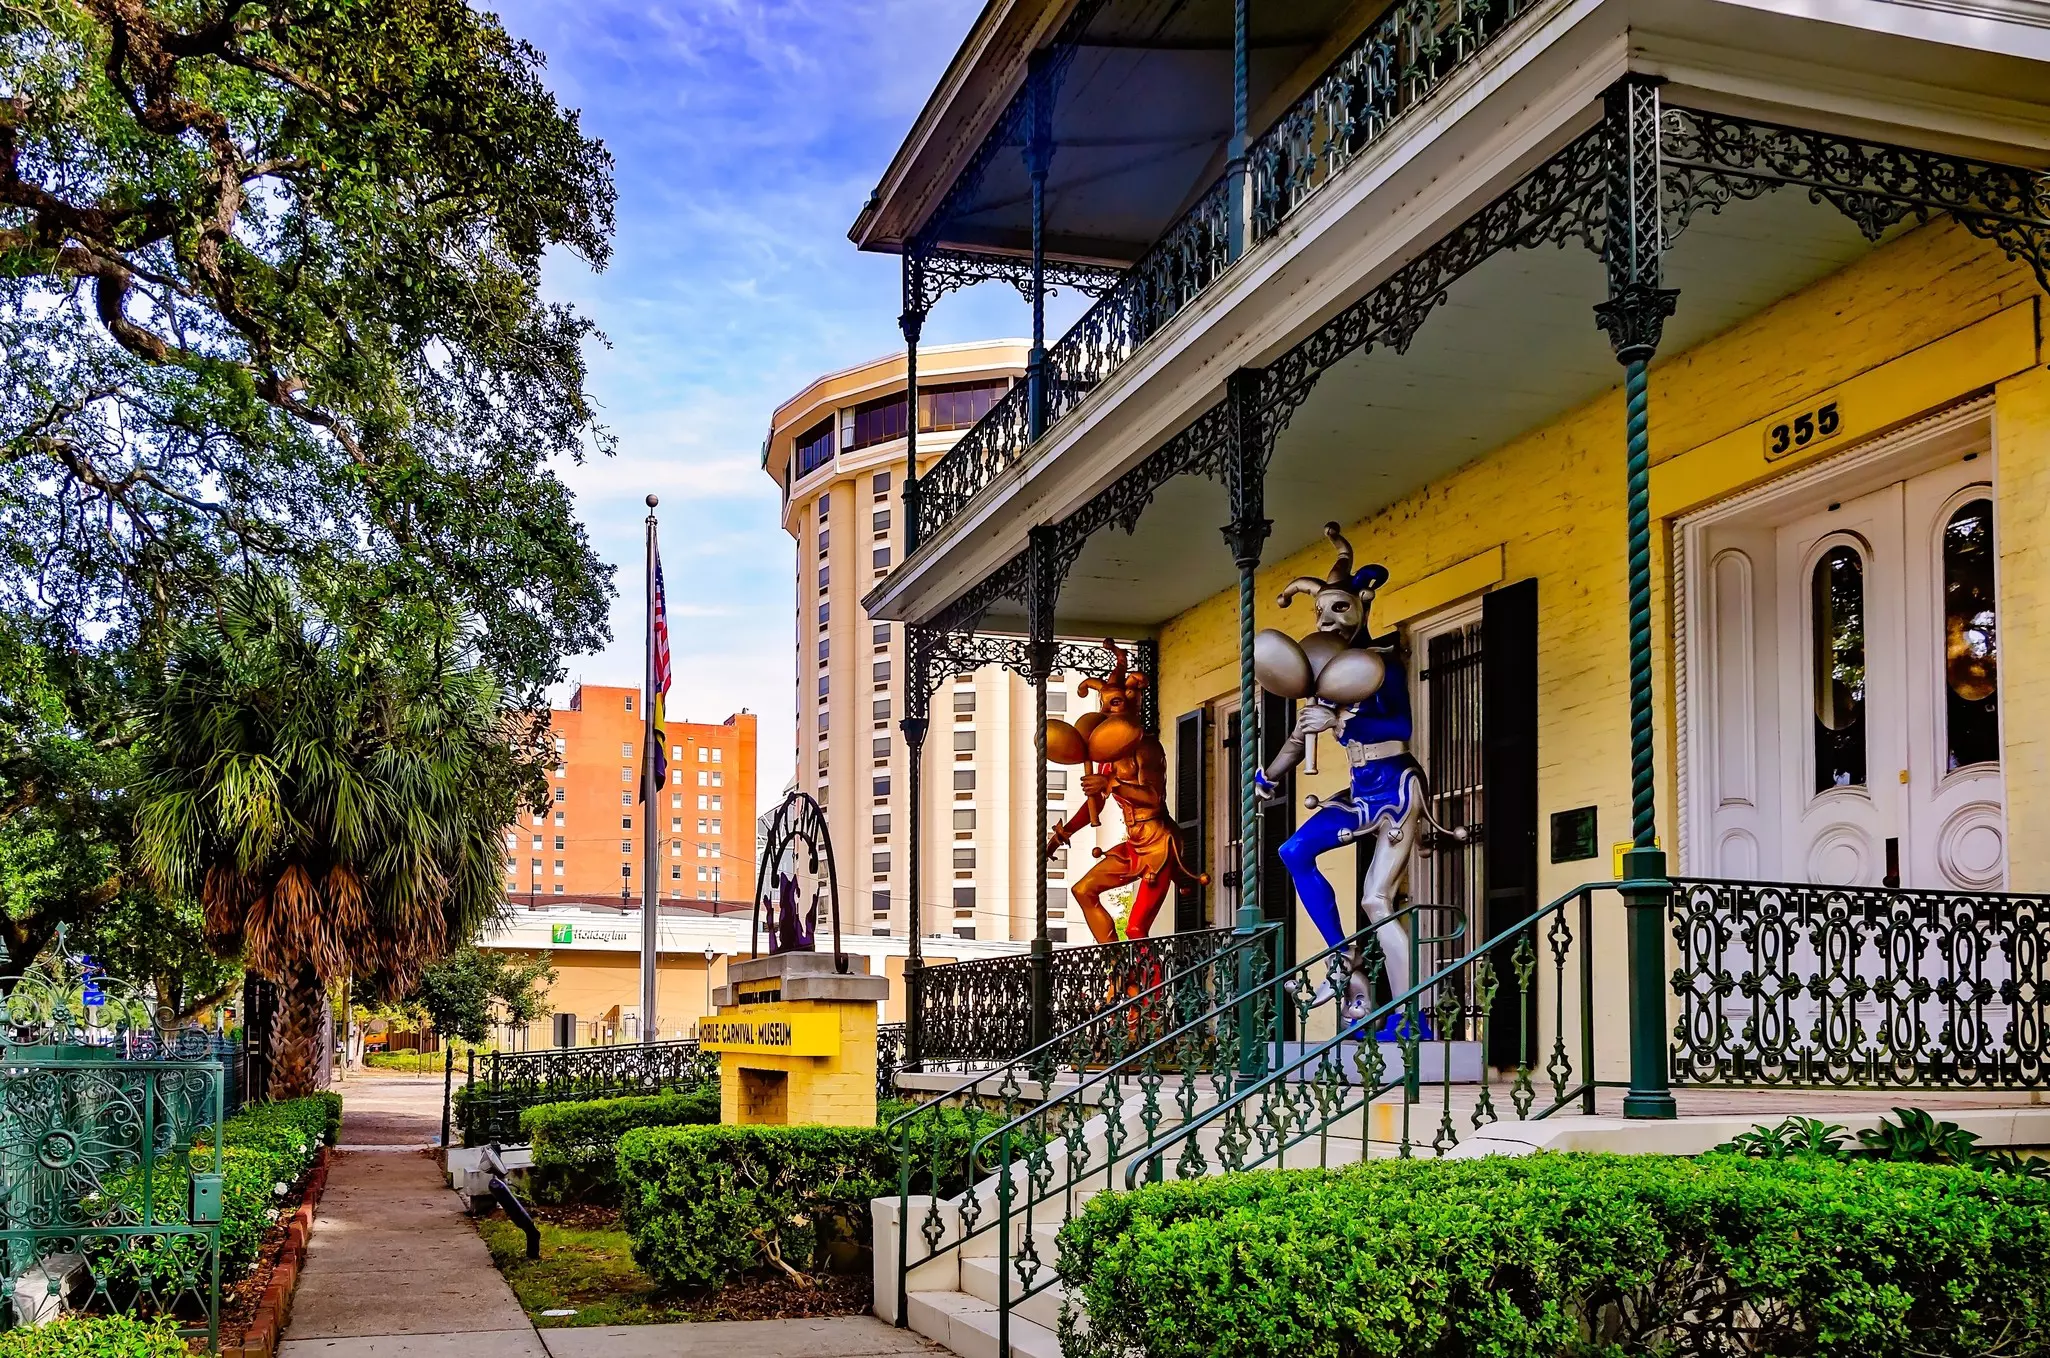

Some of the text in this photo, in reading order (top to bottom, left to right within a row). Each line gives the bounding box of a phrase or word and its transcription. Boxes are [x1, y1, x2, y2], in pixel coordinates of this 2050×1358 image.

[1771, 401, 1839, 454] 355
[574, 929, 611, 942] Holiday
[612, 930, 627, 940] Inn
[699, 1022, 791, 1046] MOBILE CARNIVAL MUSEUM
